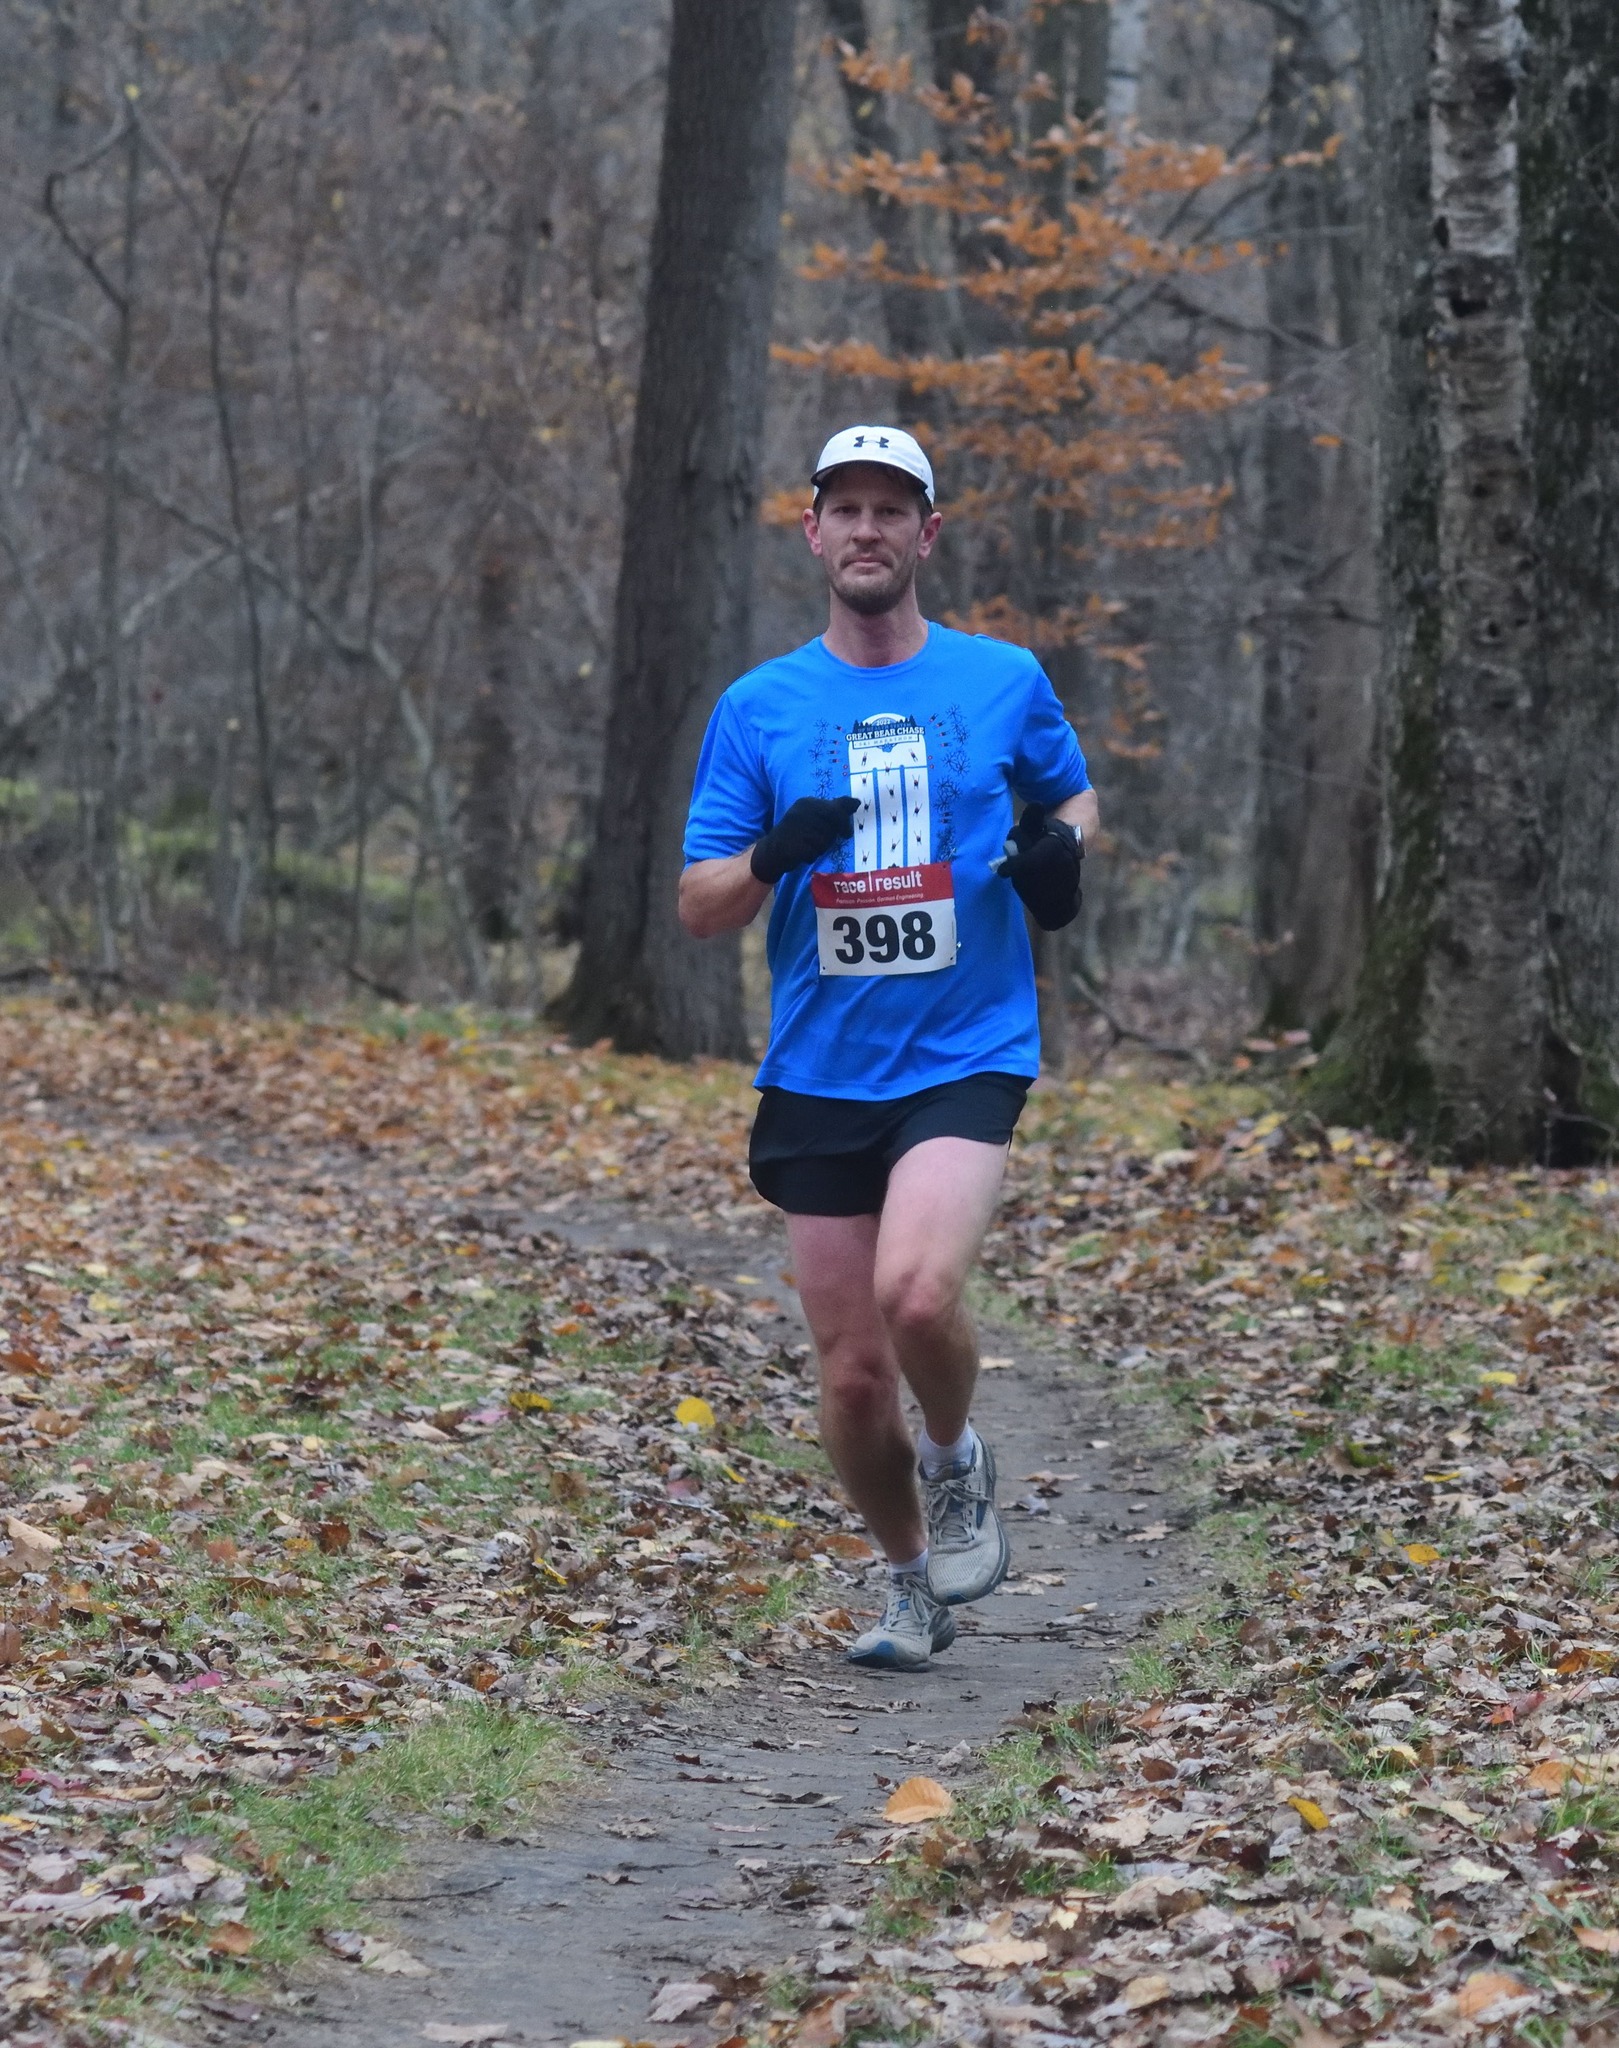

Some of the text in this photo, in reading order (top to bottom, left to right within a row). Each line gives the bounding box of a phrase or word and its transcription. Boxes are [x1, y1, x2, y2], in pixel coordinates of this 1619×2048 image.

[846, 726, 924, 741] GREAT BEAR CHASE
[874, 736, 913, 744] MARATHON
[833, 870, 922, 893] race result
[832, 910, 936, 965] 398
